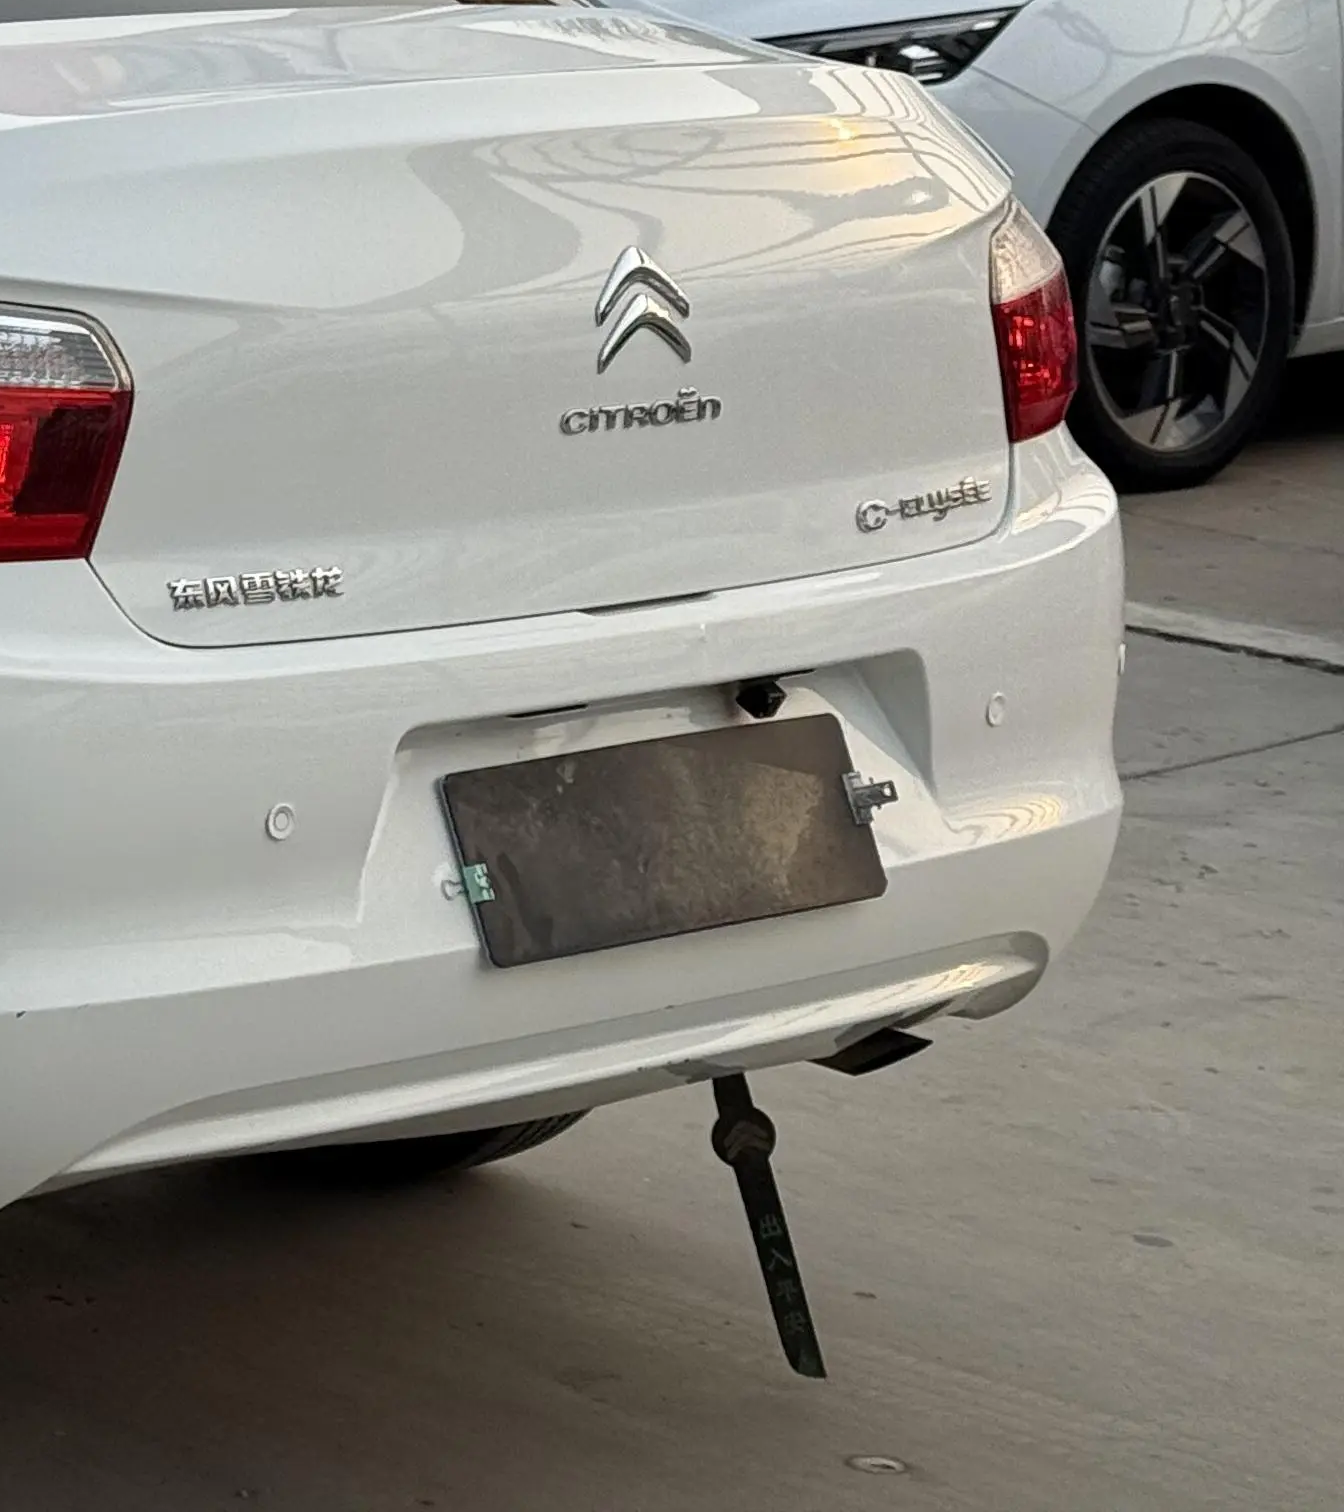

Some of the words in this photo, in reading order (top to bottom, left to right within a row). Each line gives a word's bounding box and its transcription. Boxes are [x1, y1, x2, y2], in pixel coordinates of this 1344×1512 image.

[167, 566, 345, 611] 东风雪铁龙
